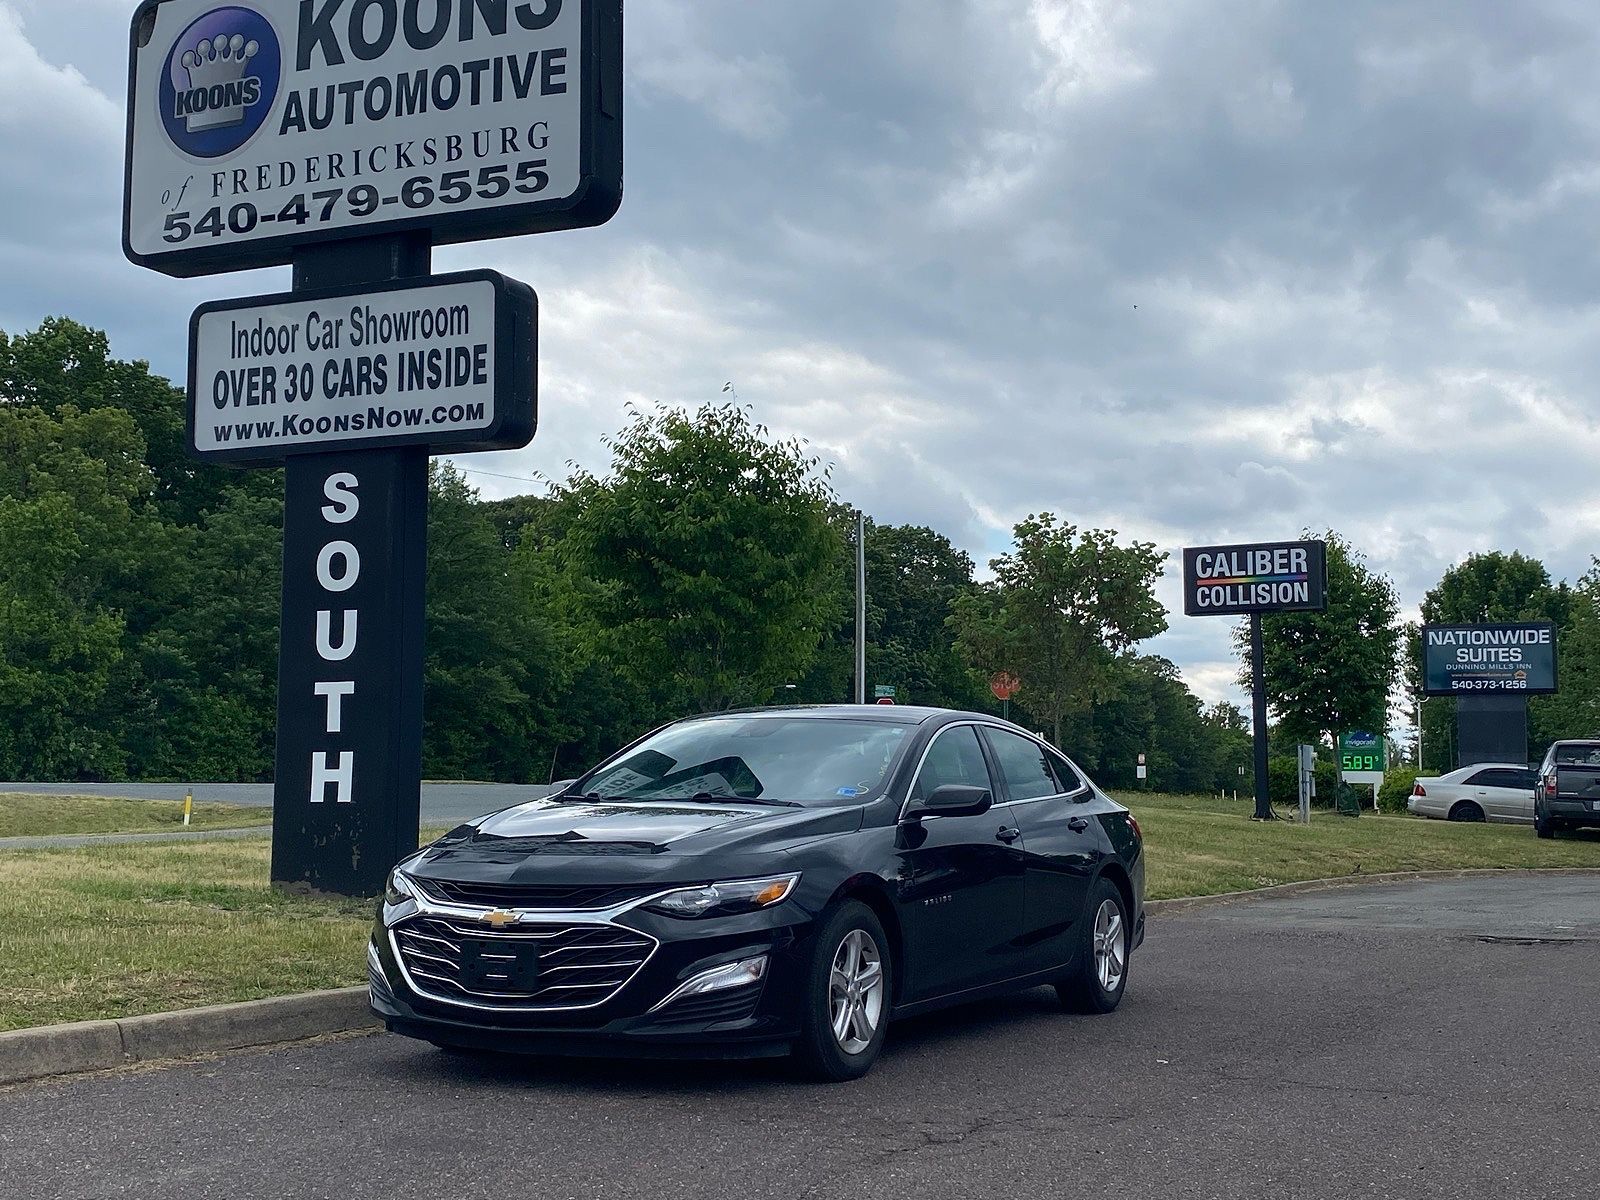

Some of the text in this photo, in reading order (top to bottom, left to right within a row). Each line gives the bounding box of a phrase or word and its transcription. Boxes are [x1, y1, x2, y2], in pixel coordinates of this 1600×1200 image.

[176, 78, 260, 116] KOONS
[278, 48, 568, 135] AUTOMOTIVE
[161, 121, 551, 211] of FREDERICKSBURG
[162, 160, 550, 243] 540-479-6555
[231, 304, 469, 359] Indoor Car Showroom
[213, 344, 488, 410] OVER 30 CARS INSIDE
[1195, 548, 1308, 578] CALIBER
[1197, 582, 1309, 607] COLLISION
[310, 472, 360, 803] SOUTH
[1428, 629, 1550, 645] NATIONWIDE
[1456, 647, 1523, 662] SUITES
[1451, 680, 1527, 689] 540-373-1256
